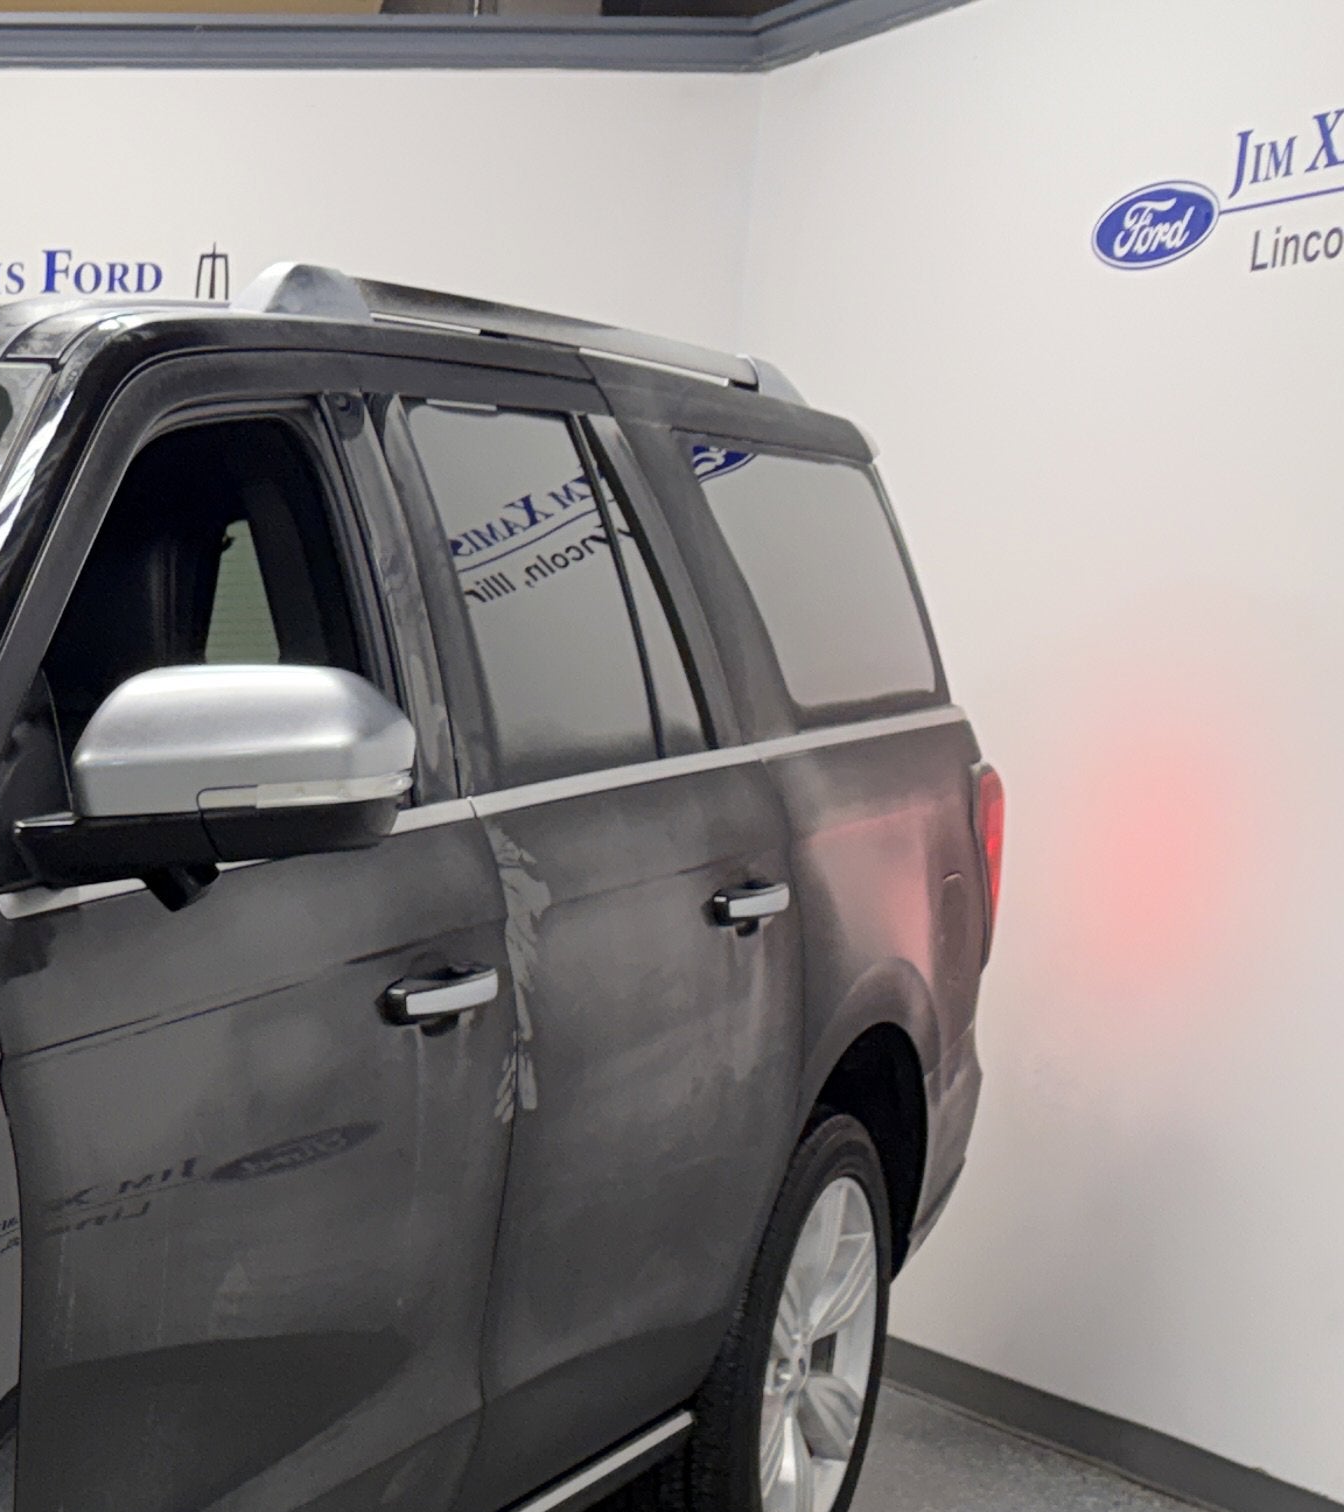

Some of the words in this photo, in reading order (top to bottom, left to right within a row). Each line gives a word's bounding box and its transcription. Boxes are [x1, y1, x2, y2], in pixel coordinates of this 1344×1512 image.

[1227, 128, 1299, 200] JIM
[1113, 197, 1196, 258] Ford
[1250, 226, 1344, 272] Linco
[42, 249, 164, 294] FORD
